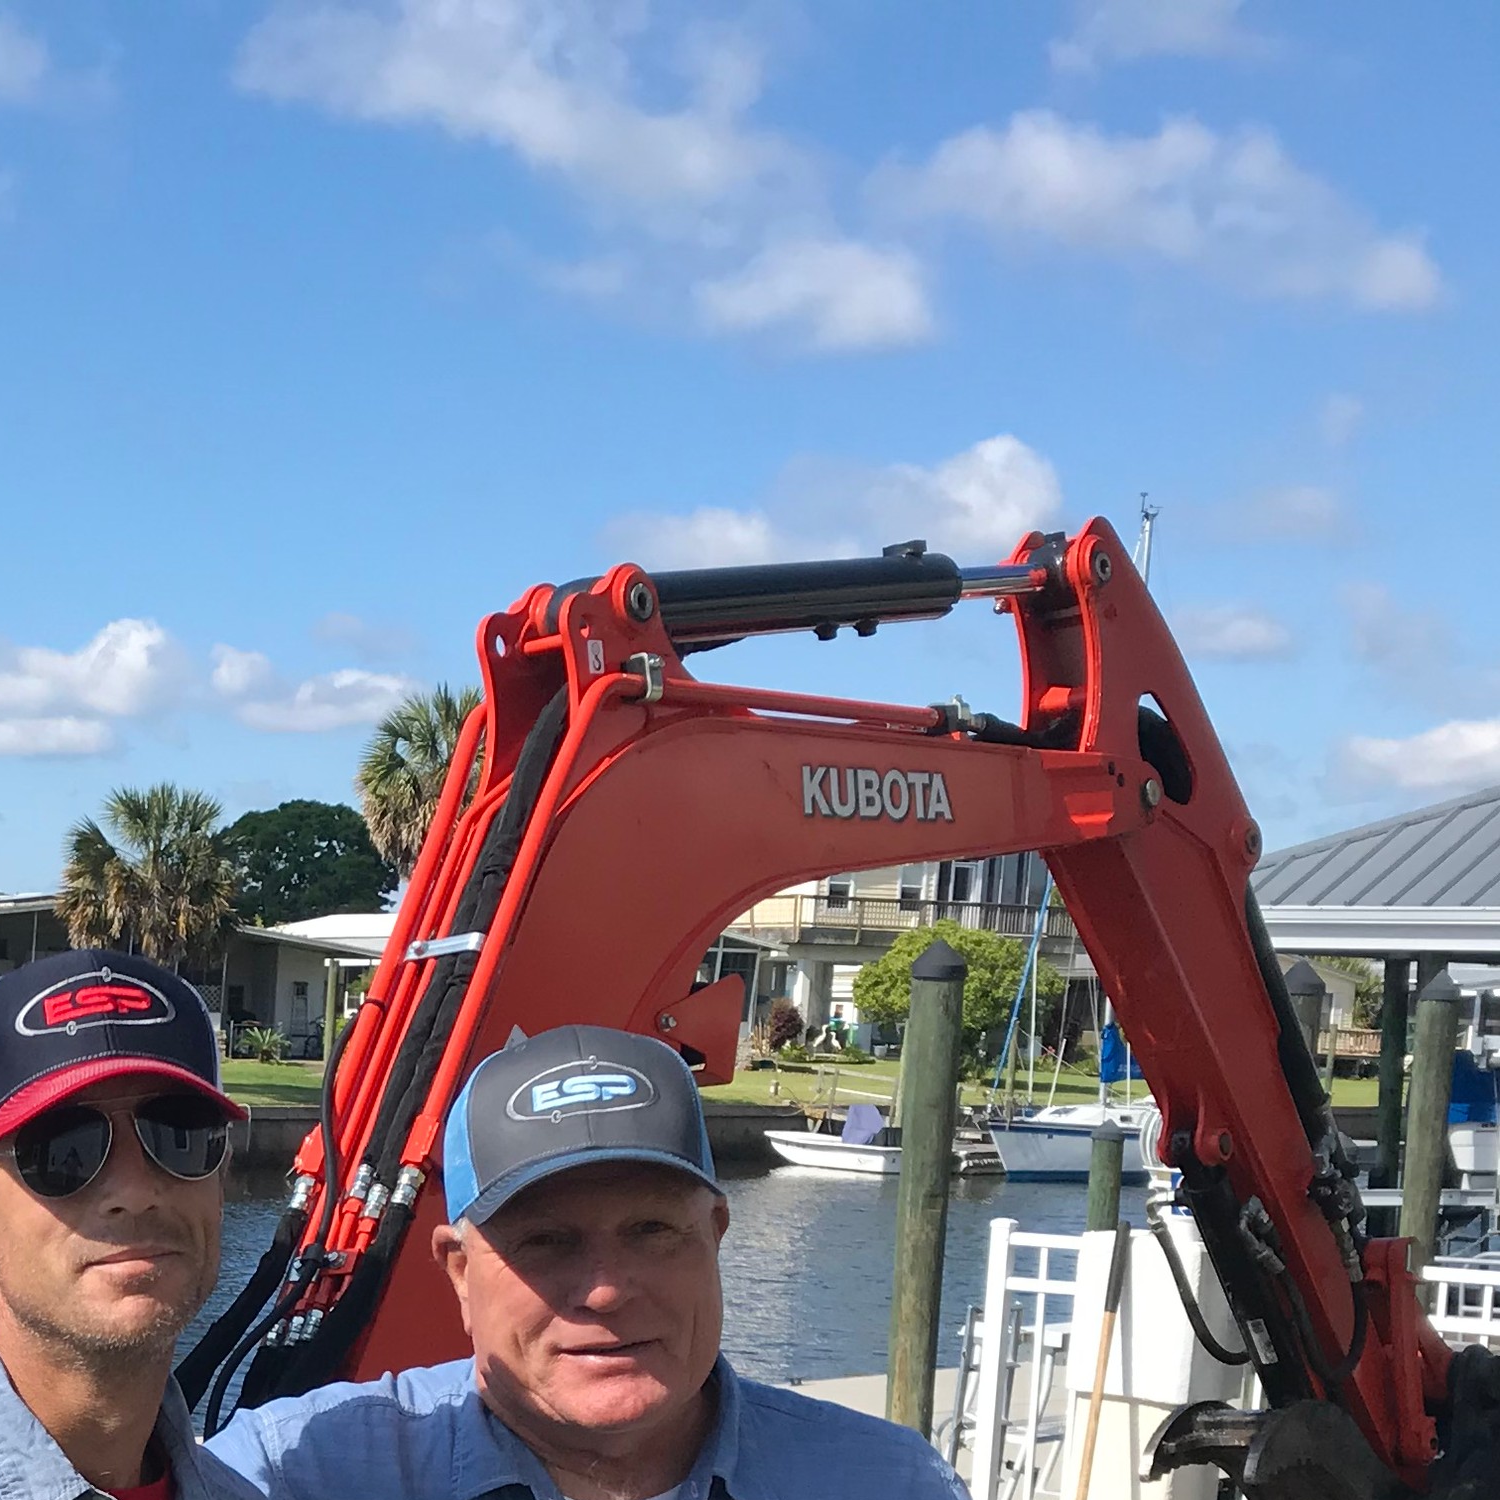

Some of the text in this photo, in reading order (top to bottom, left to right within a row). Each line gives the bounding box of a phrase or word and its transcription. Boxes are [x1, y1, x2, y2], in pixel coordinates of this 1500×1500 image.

[802, 765, 954, 822] KUBOTA
[43, 984, 152, 1026] ESP
[531, 1073, 637, 1113] ESP
